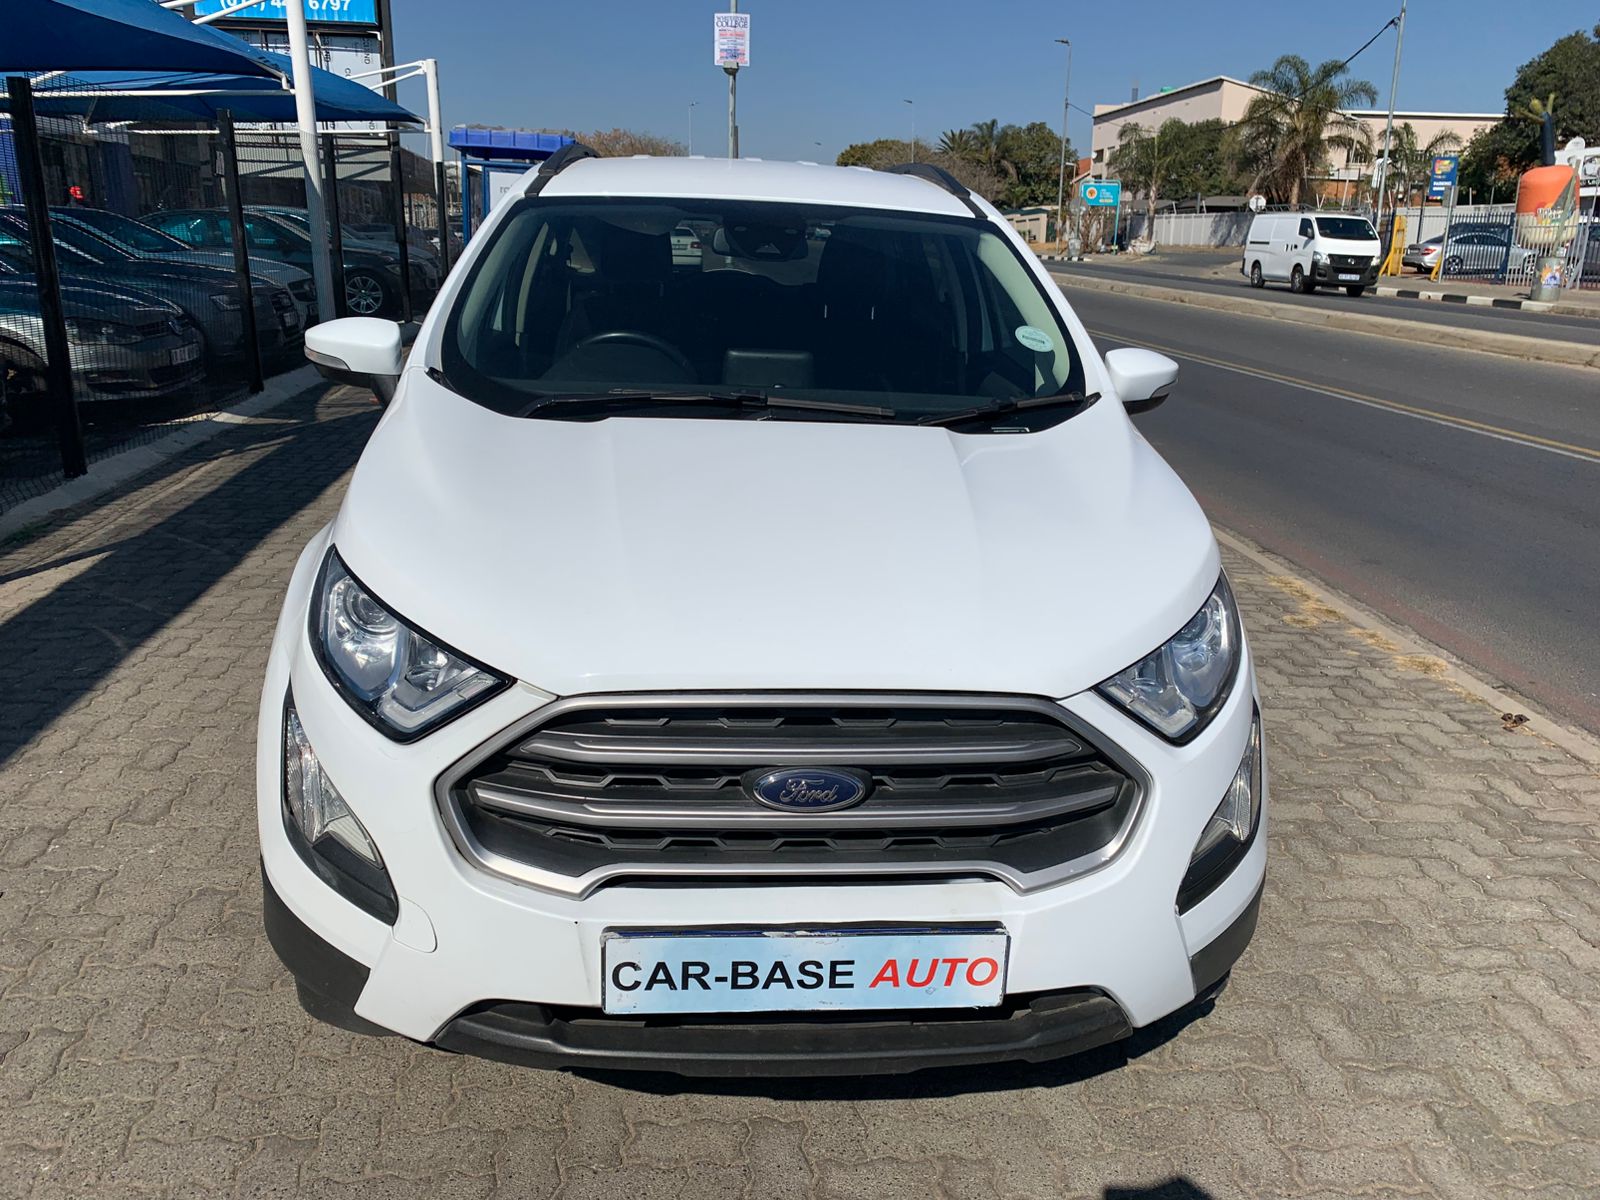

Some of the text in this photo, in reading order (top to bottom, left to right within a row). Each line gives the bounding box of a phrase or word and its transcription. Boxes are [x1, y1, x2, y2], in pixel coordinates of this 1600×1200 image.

[308, 0, 351, 11] 6797
[716, 20, 748, 28] COLLEGE
[780, 779, 839, 803] Ford
[611, 957, 999, 991] CAR-BASE AUTO
